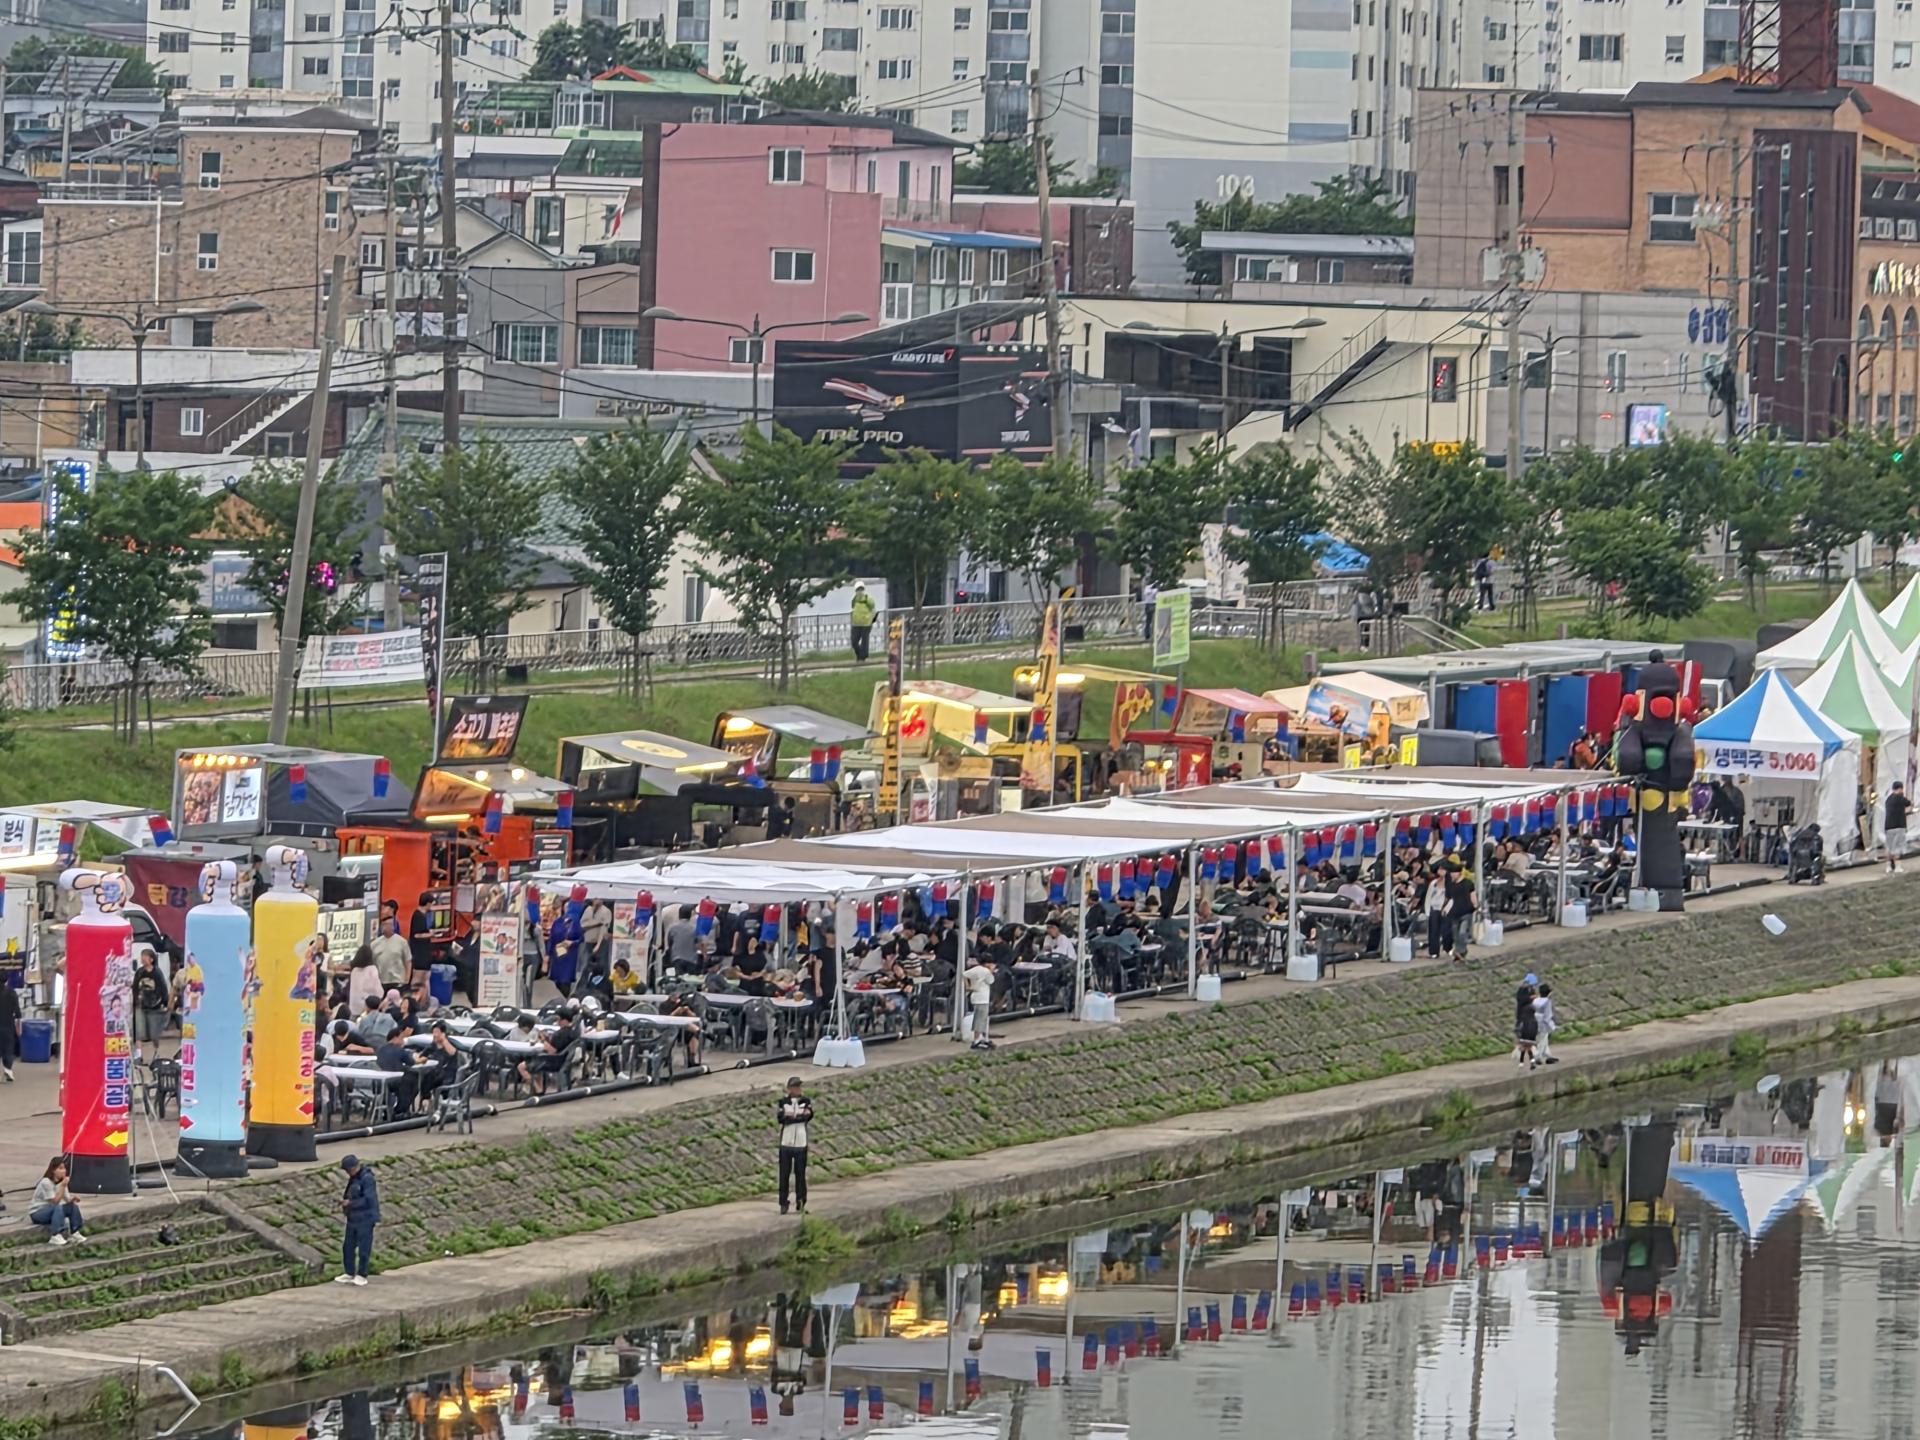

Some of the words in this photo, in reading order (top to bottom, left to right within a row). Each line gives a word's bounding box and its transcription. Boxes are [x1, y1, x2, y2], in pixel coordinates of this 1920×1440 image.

[817, 428, 860, 441] TIRE
[863, 430, 904, 443] PRO
[1714, 747, 1764, 769] 생맥주
[1769, 751, 1816, 771] 5,000
